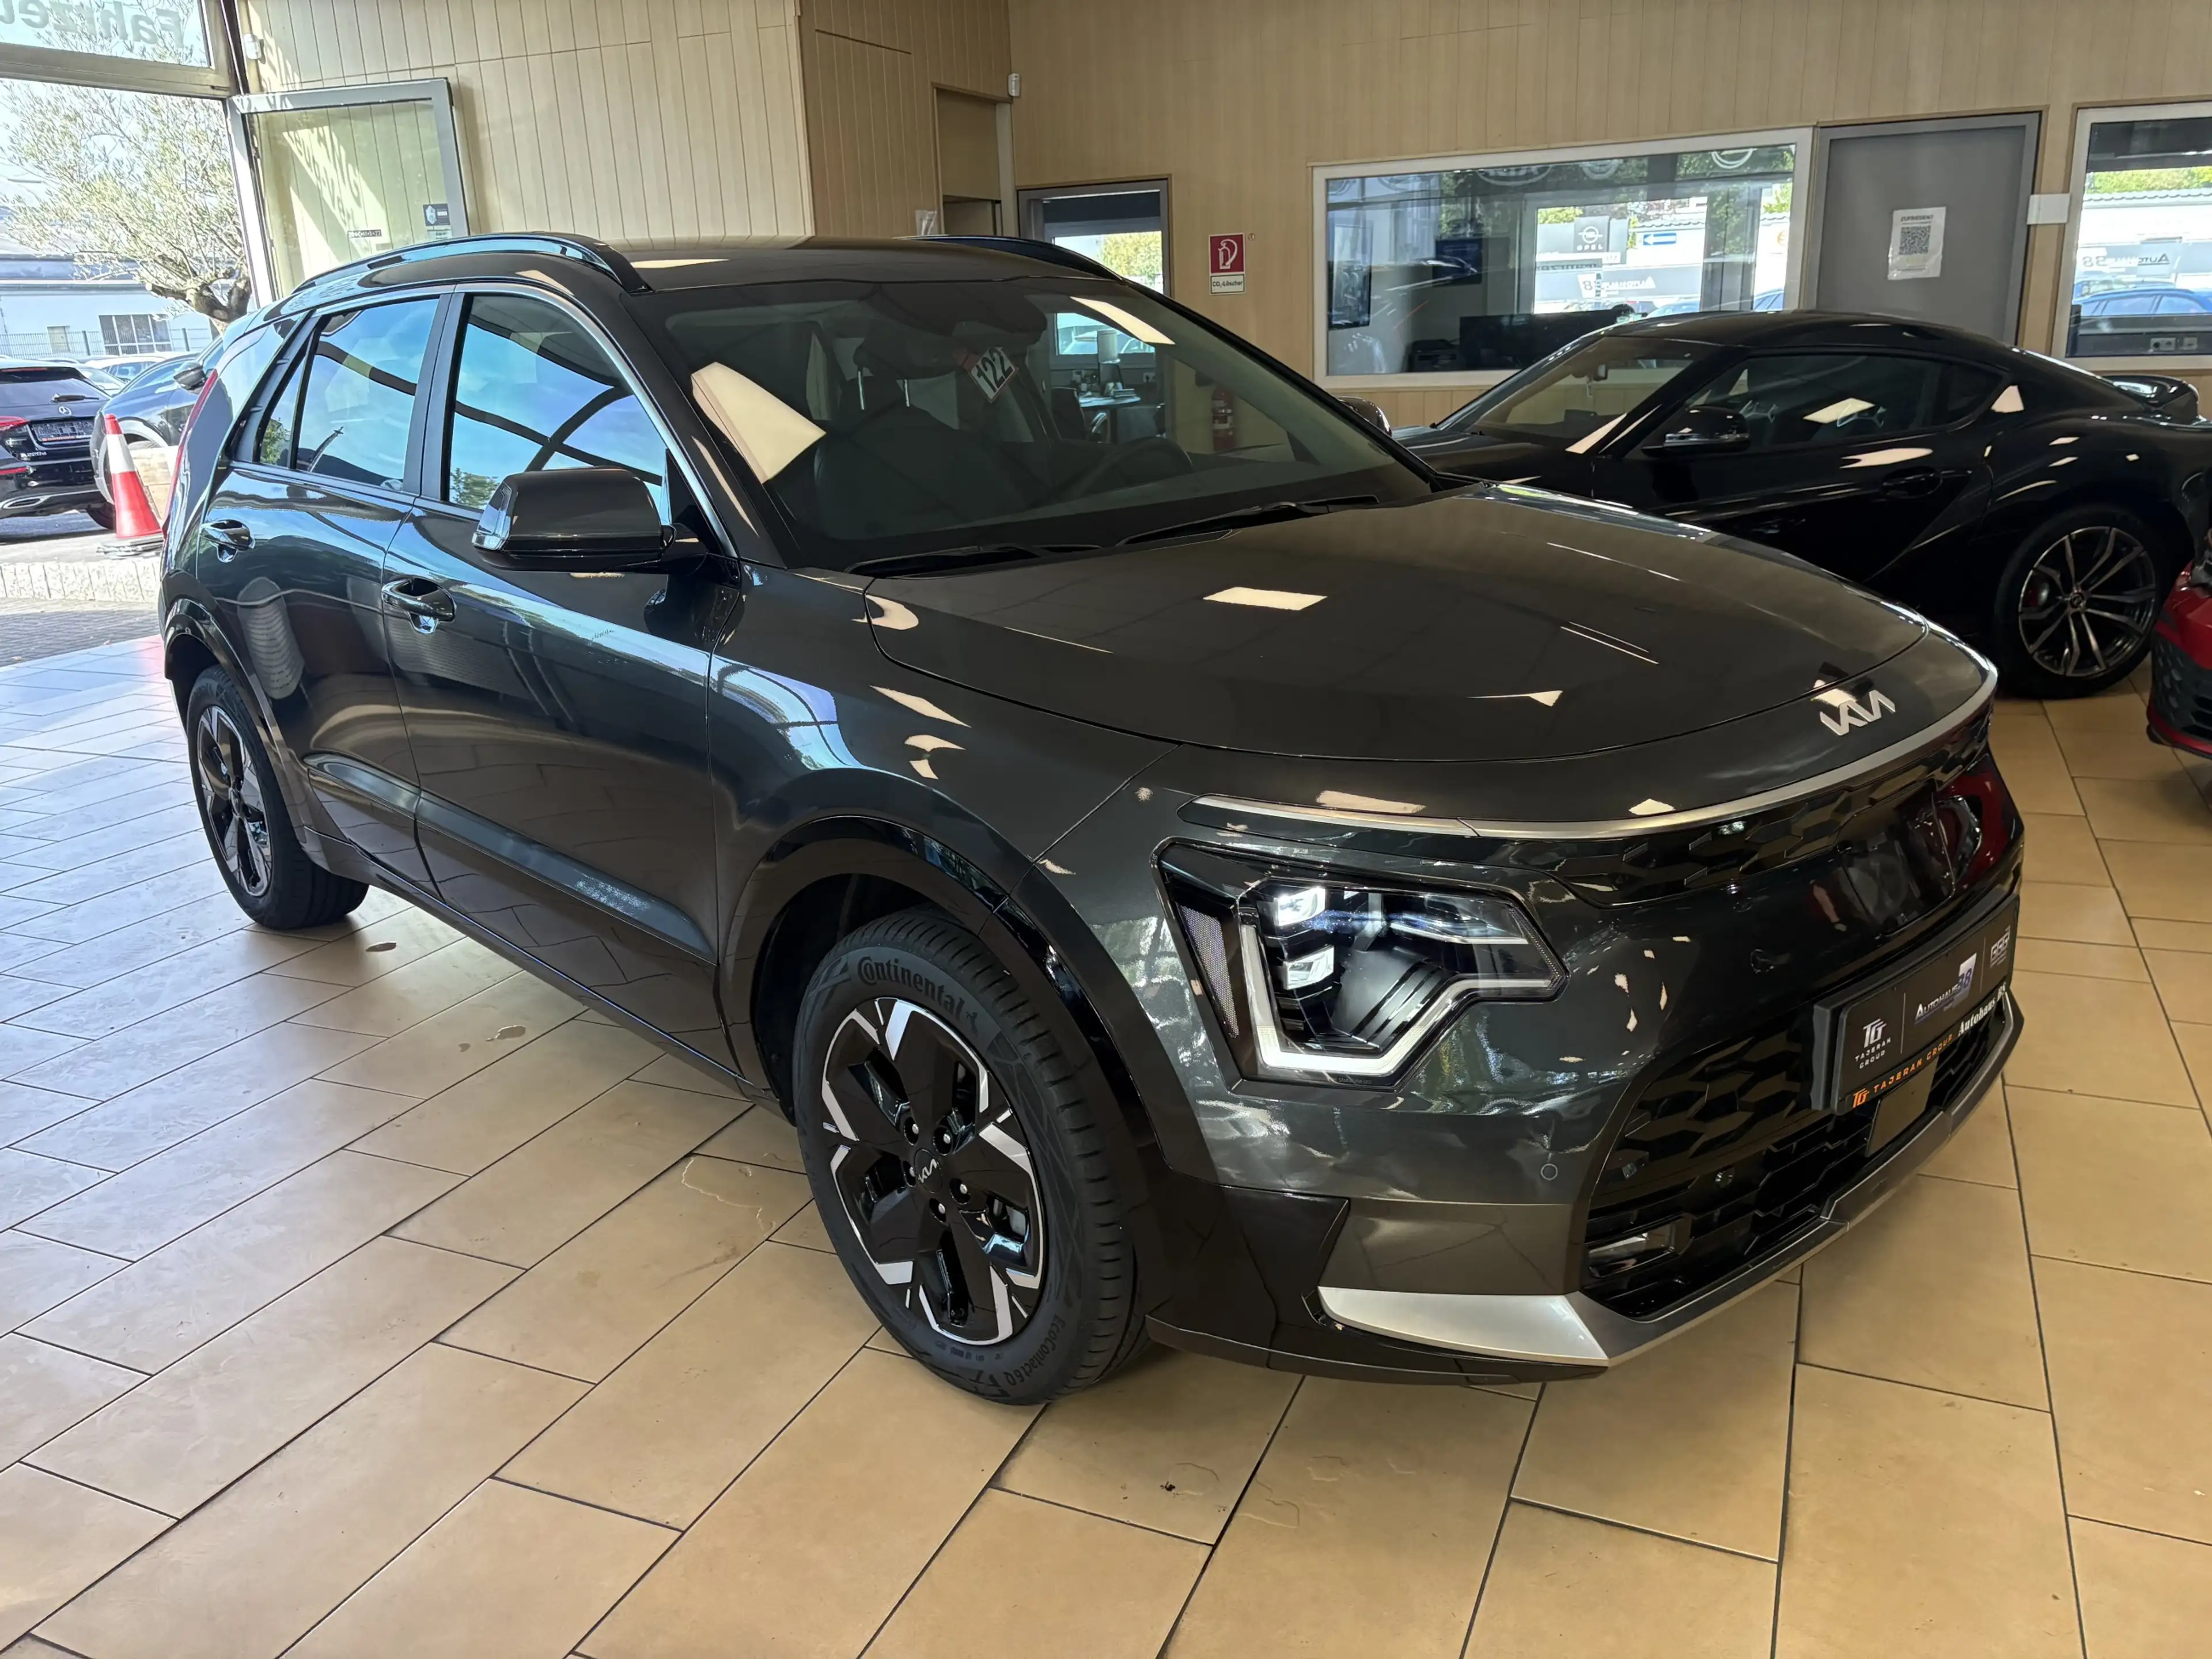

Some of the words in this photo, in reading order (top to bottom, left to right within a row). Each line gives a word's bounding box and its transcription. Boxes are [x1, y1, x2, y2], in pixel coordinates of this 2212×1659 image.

[976, 347, 1014, 393] 122
[1820, 690, 1896, 736] KIA
[857, 956, 965, 1022] Continental
[1855, 1037, 1891, 1062] TAJERAN
[1859, 1050, 1885, 1069] GROUP
[1873, 1058, 1922, 1093] TAJERAN
[1926, 1034, 1953, 1060] GROUP
[1958, 999, 1996, 1037] Autohaus
